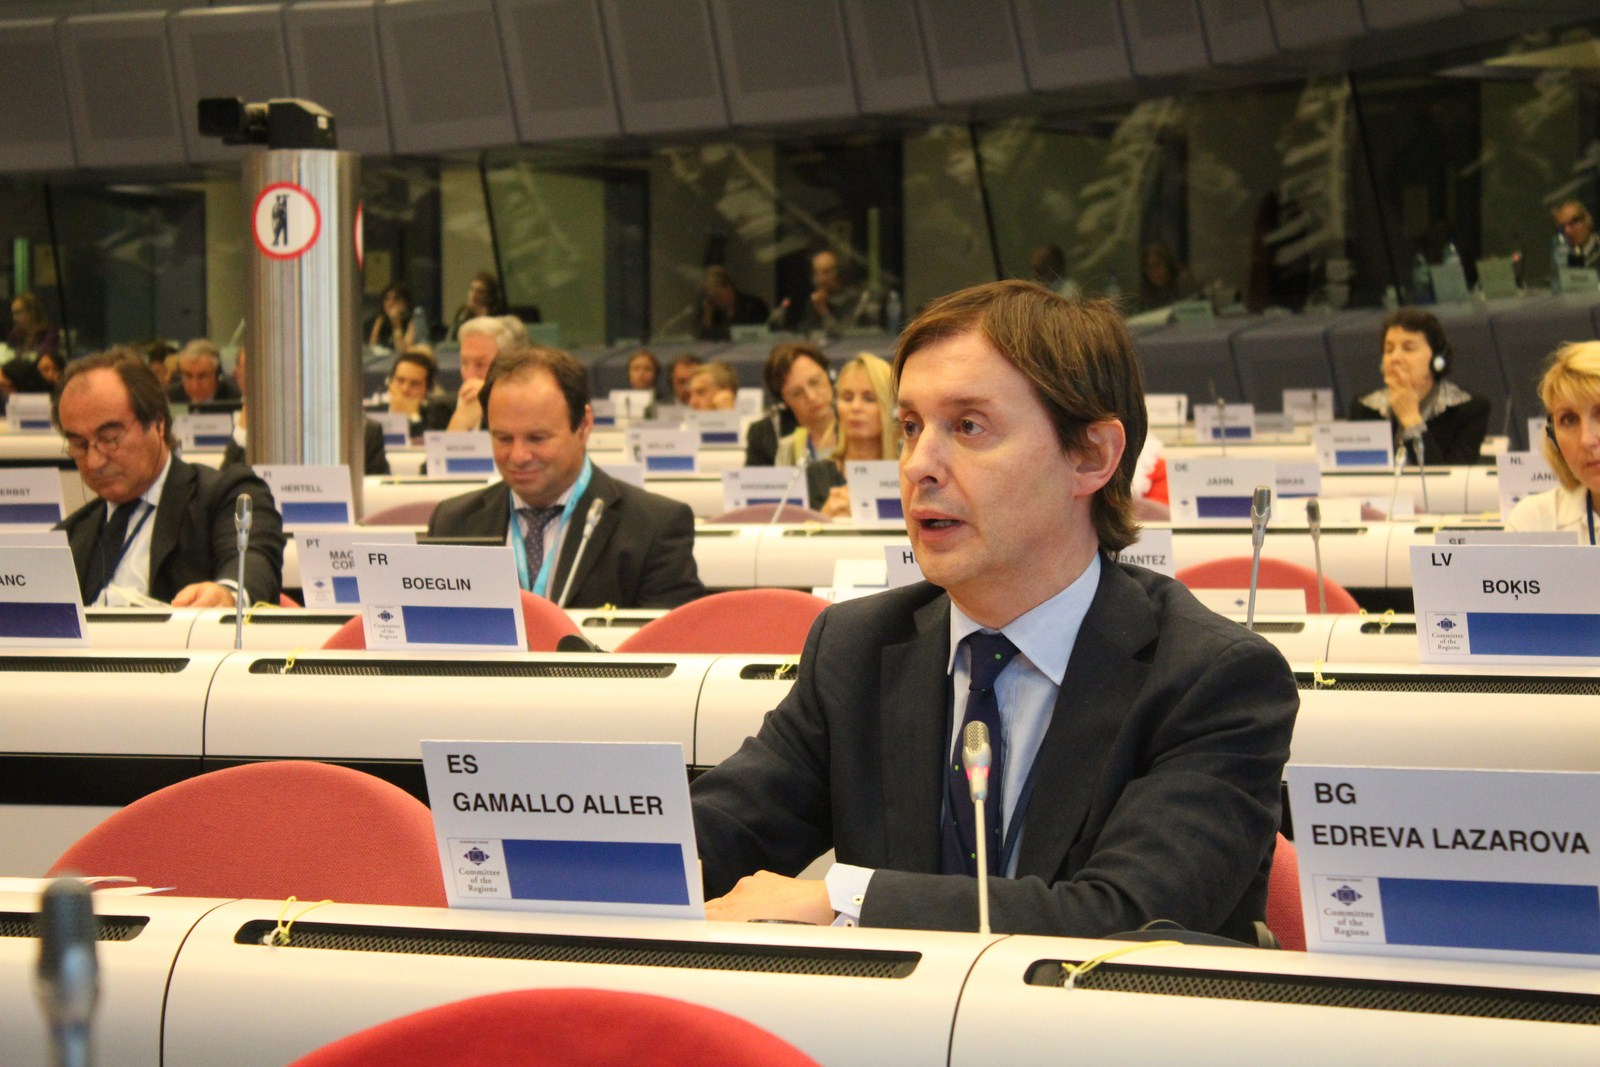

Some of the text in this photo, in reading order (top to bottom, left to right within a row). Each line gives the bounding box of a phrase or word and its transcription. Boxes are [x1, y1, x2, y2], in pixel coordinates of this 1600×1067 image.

[1206, 477, 1234, 486] JAHN
[281, 484, 323, 493] HERTELL
[306, 538, 320, 548] PT
[368, 553, 388, 566] FR
[902, 551, 914, 564] H
[1431, 552, 1453, 567] LV
[402, 577, 471, 591] BOEGLIN
[1482, 579, 1541, 601] BOĶIS
[447, 754, 479, 774] ES
[1314, 782, 1356, 804] BG
[453, 792, 664, 816] GAMALLO ALLER
[1311, 824, 1590, 854] EDREVA LAZAROVA
[458, 867, 501, 876] Committee
[470, 876, 492, 884] of the
[468, 884, 498, 895] Regions
[1323, 907, 1375, 918] Committee
[1337, 918, 1363, 927] of the
[1334, 926, 1370, 937] Regions
